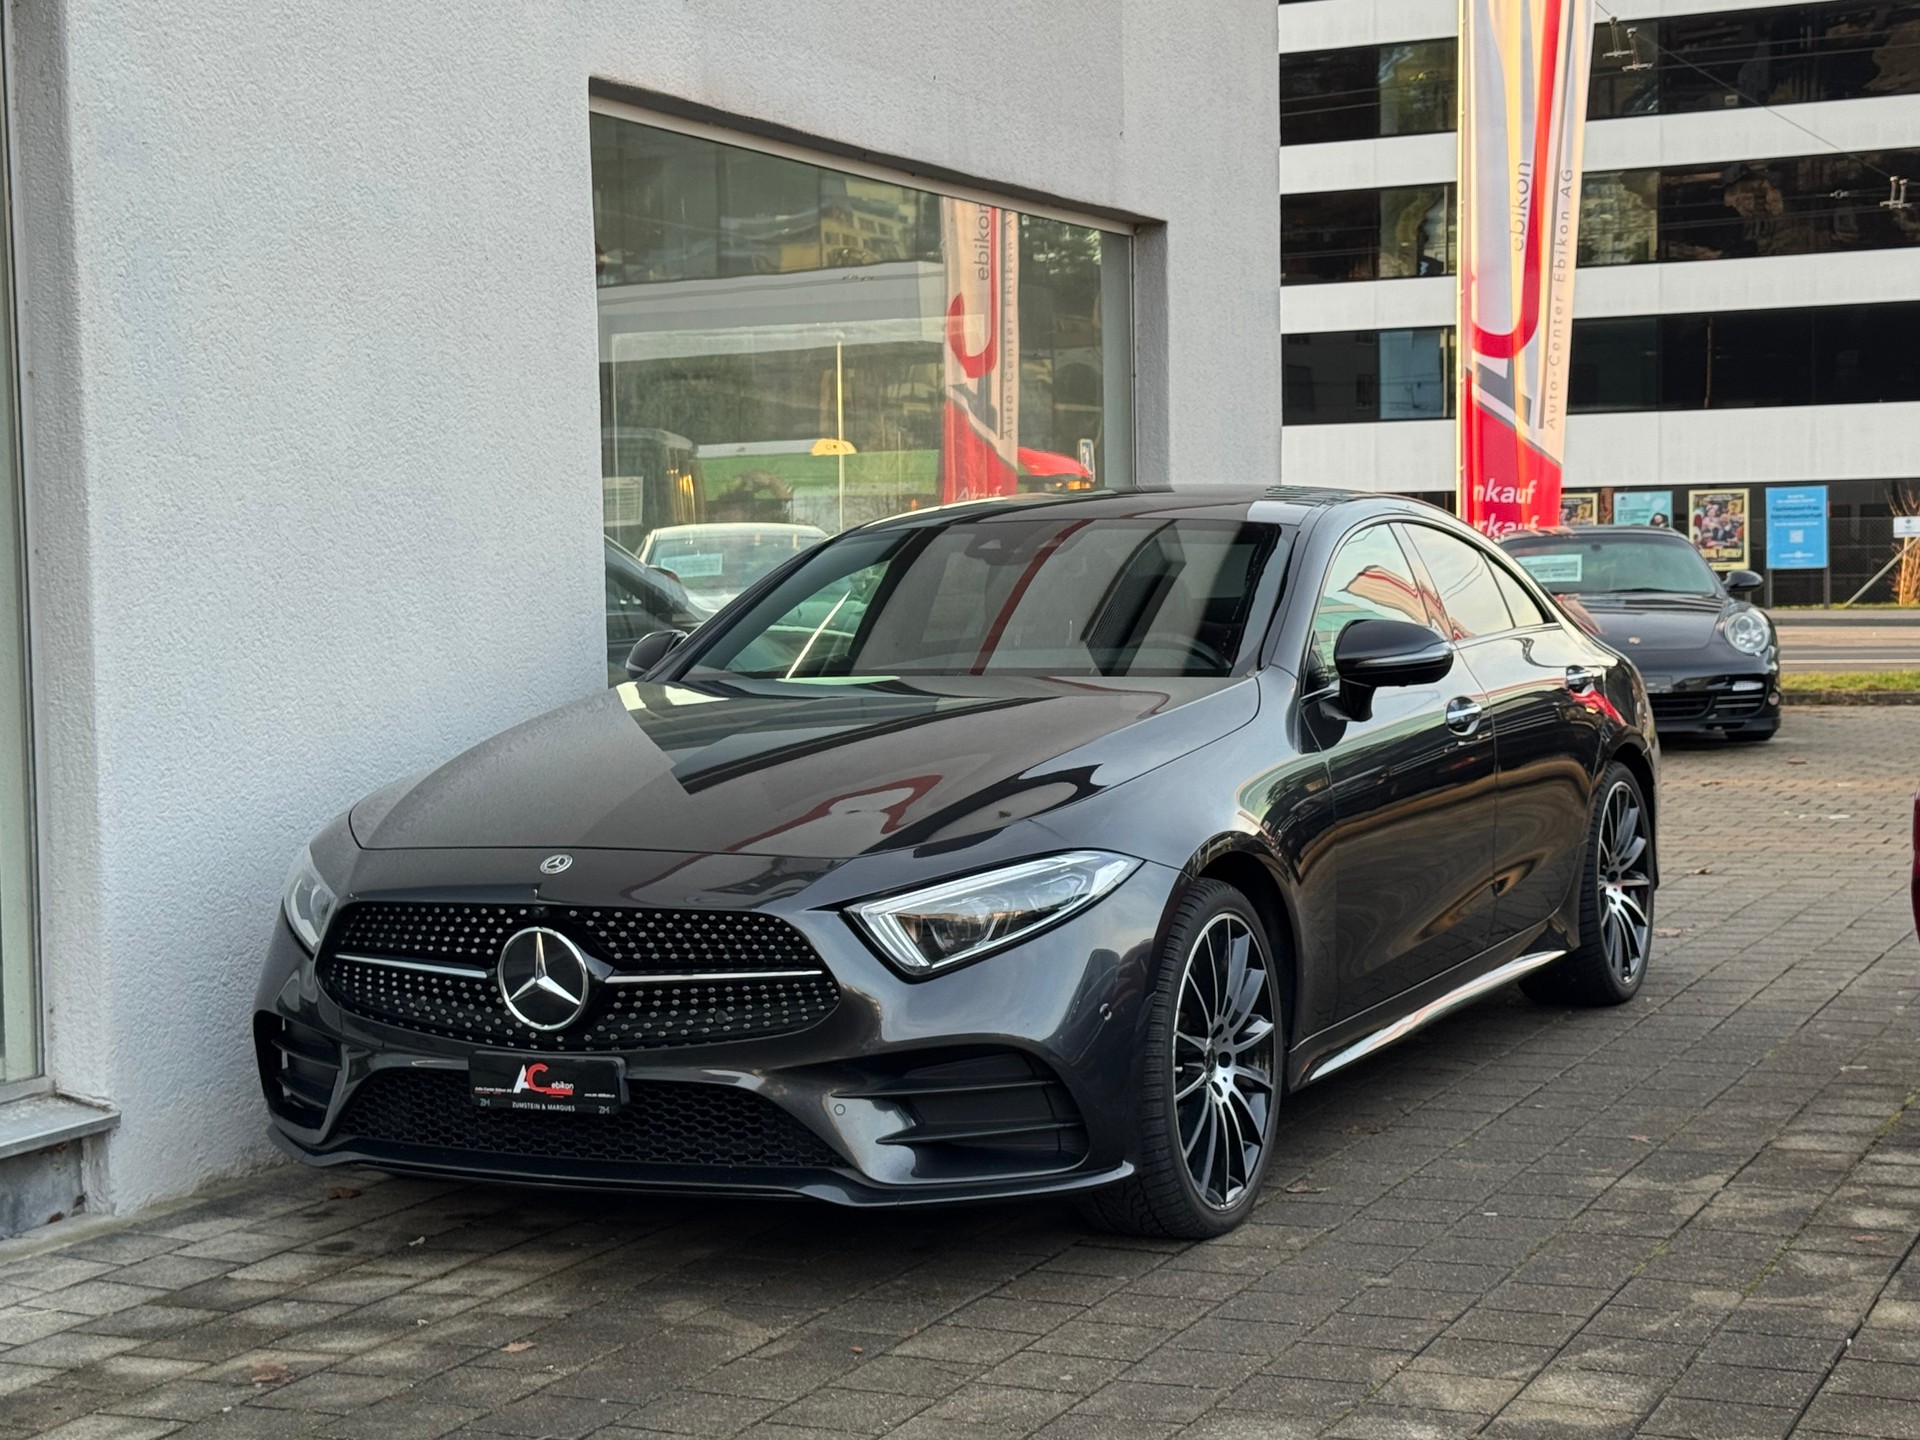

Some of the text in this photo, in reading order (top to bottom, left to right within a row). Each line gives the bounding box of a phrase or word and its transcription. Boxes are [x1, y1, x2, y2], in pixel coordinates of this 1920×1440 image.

[1546, 169, 1573, 430] Auto-Center Ebikon AG
[1473, 478, 1538, 504] nkauf
[551, 1081, 574, 1090] ebikon
[512, 1101, 541, 1110] ZUMSTEIN
[547, 1104, 575, 1112] MARQUES
